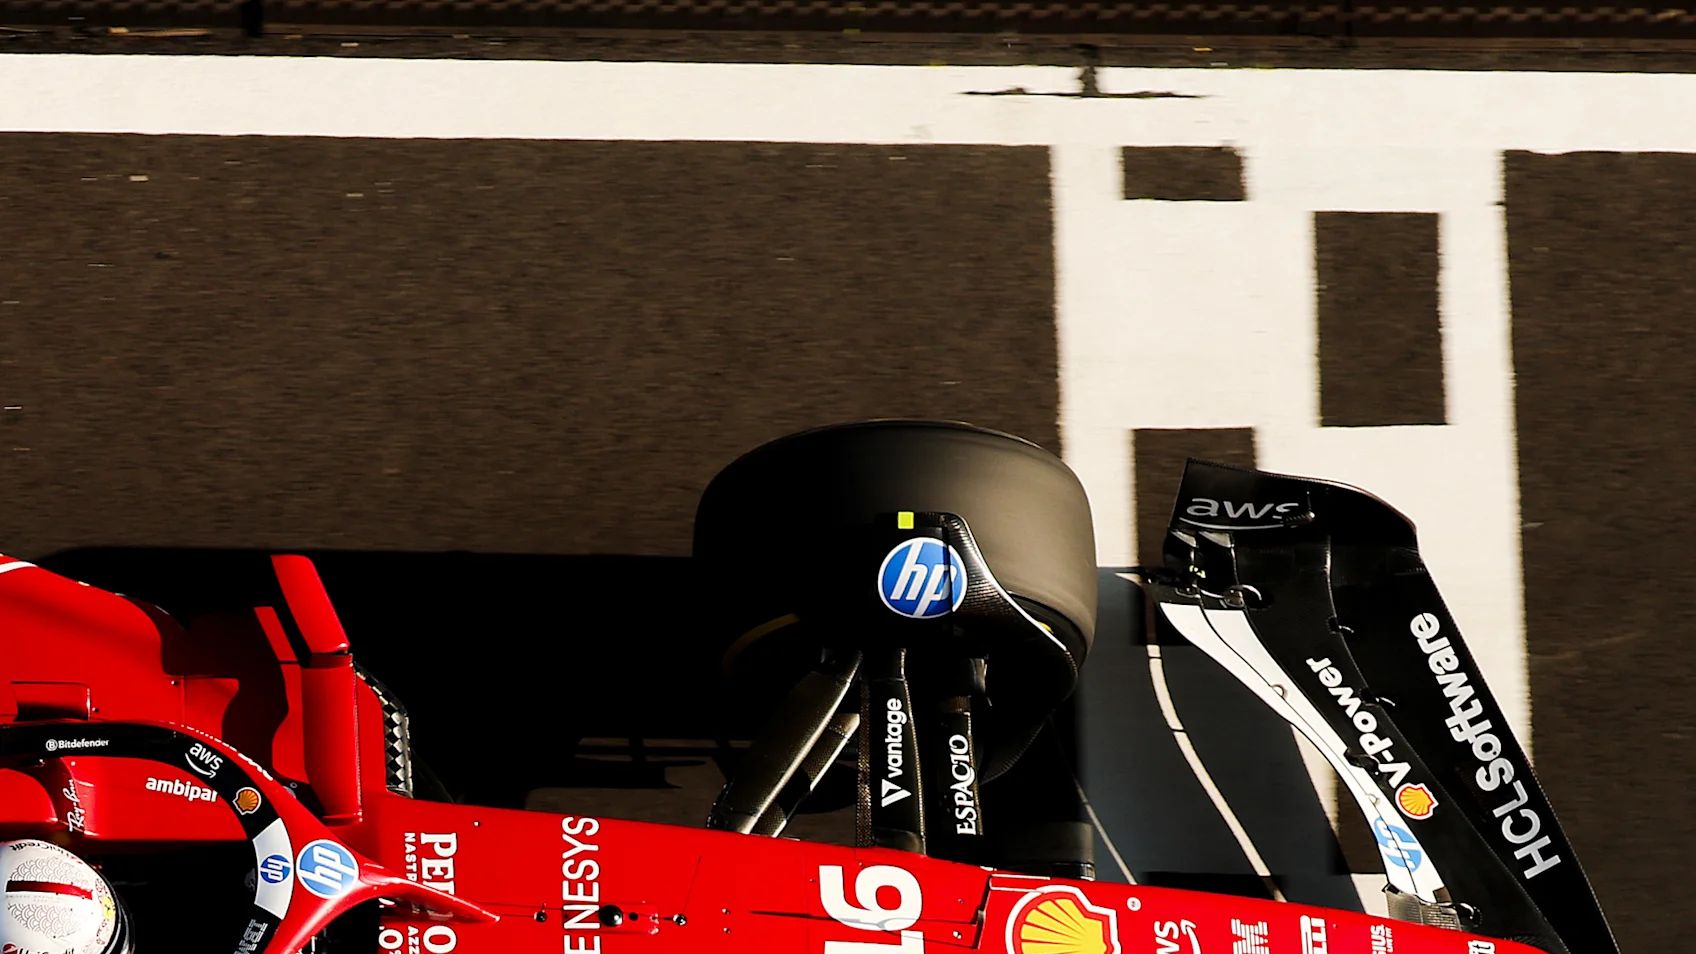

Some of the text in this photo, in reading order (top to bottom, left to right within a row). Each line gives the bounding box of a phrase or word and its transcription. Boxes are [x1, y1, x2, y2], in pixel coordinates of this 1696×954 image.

[1186, 496, 1299, 520] aws
[890, 540, 958, 617] hp
[58, 739, 109, 749] Bitdefender
[885, 697, 907, 778] vantage
[1306, 657, 1412, 789] V-Power
[1410, 612, 1561, 880] HCLSoftware
[189, 742, 223, 771] aws
[949, 734, 976, 835] ESPACIO
[260, 854, 290, 884] hp
[298, 843, 357, 897] hp
[405, 832, 417, 882] NASTR
